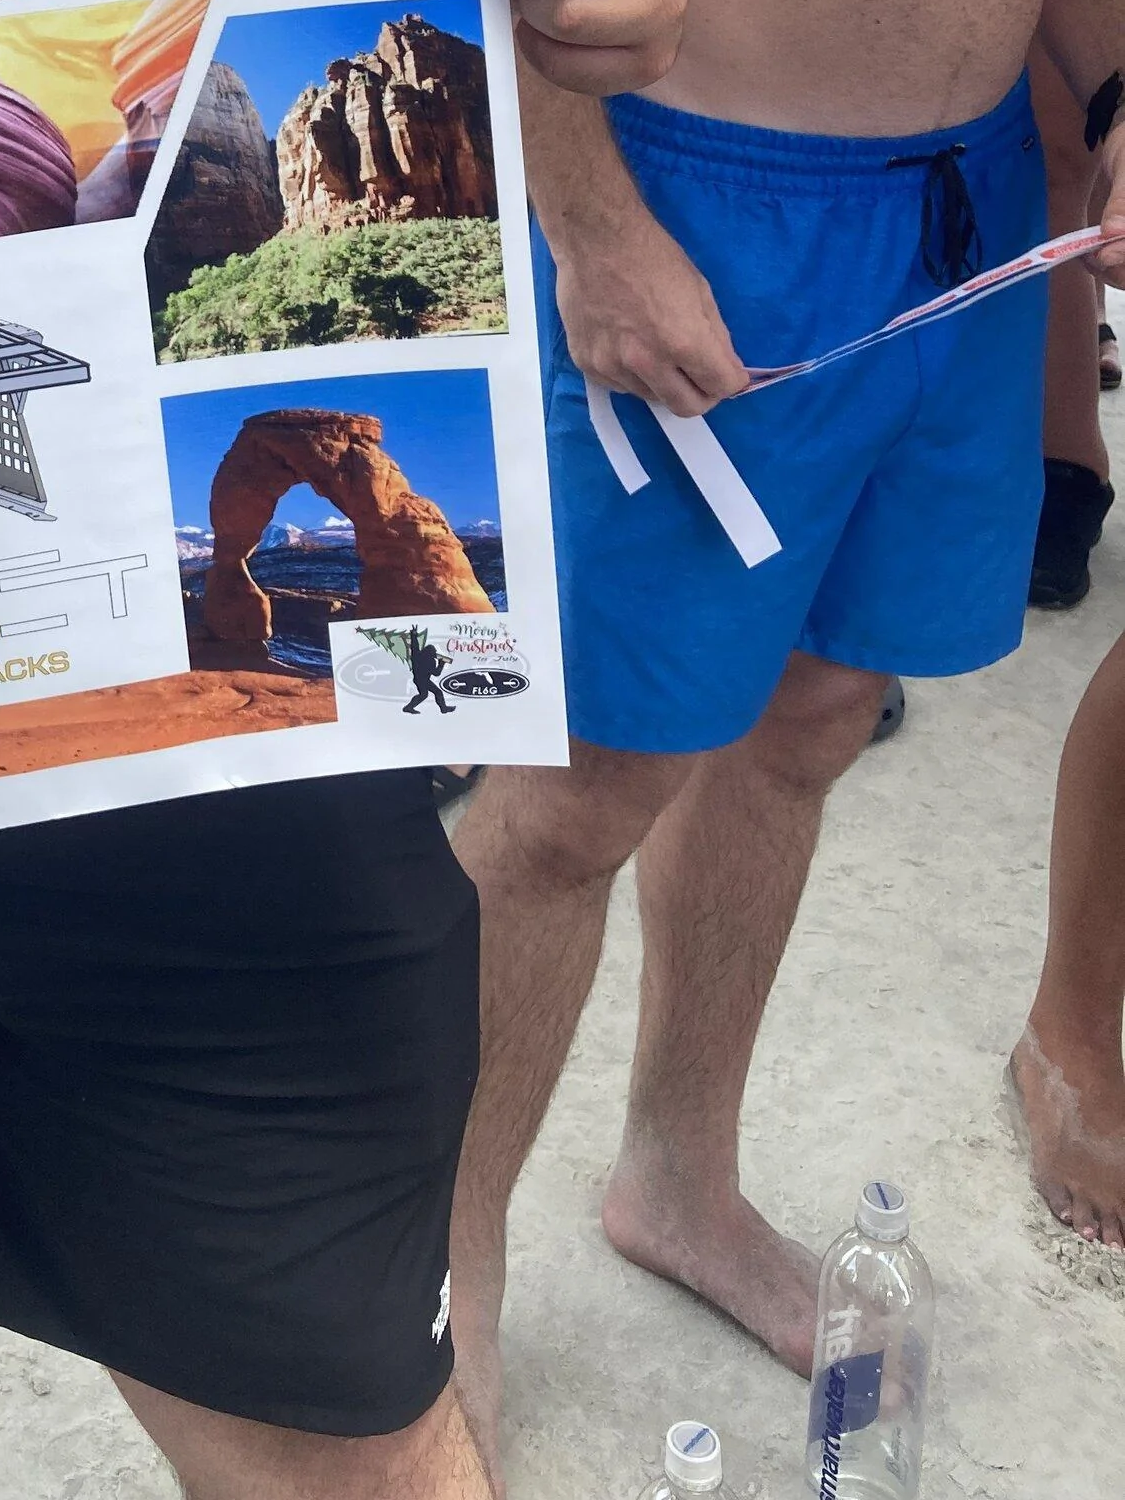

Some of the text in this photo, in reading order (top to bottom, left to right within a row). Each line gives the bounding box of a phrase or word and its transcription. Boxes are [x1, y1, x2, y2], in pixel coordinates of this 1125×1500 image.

[450, 622, 498, 640] Merry
[446, 638, 514, 654] Christmas
[472, 686, 498, 695] FL6G
